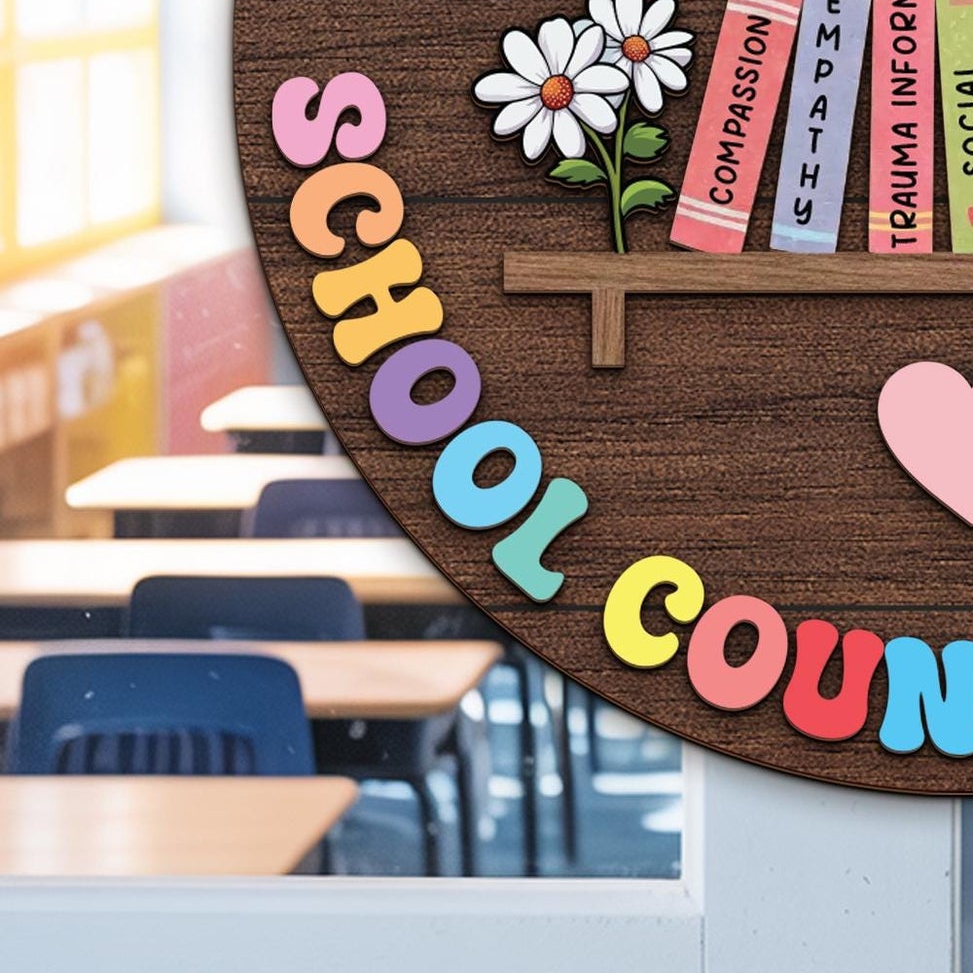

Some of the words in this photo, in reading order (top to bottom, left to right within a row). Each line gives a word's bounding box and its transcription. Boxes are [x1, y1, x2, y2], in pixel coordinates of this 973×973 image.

[709, 14, 772, 205] COMPASSION
[890, 122, 918, 249] TRAUMA
[272, 71, 589, 604] SCHOOL
